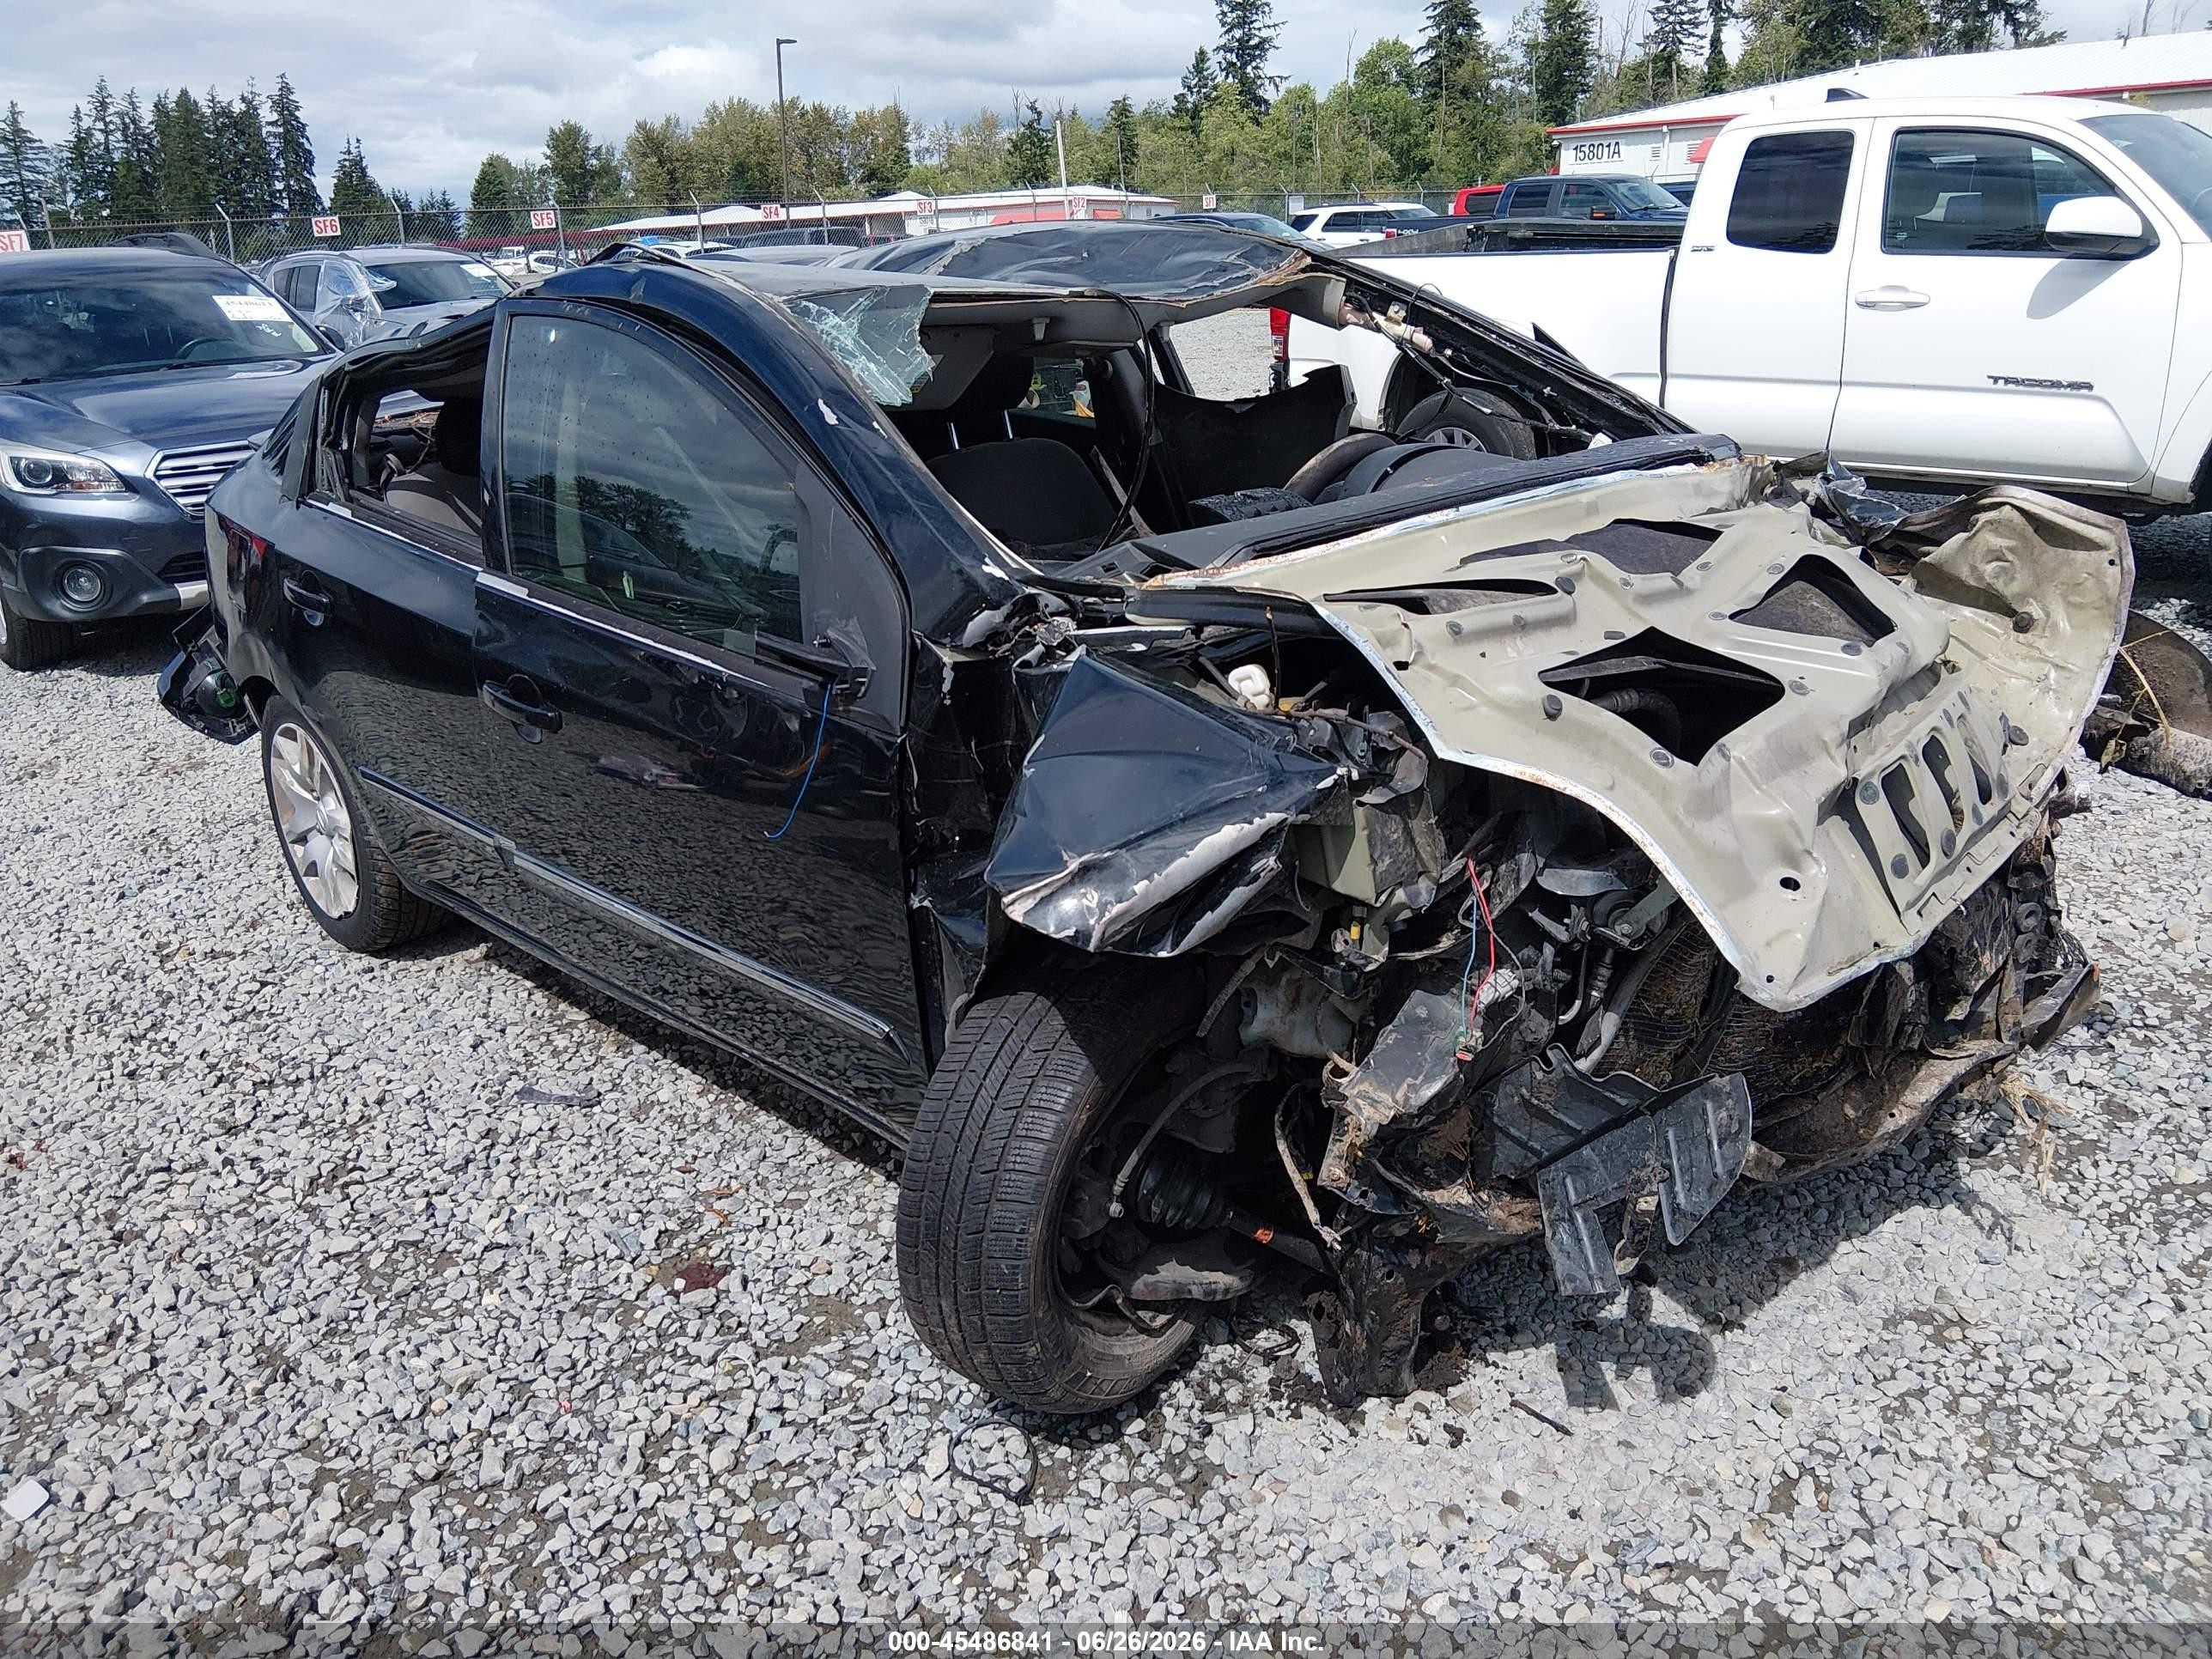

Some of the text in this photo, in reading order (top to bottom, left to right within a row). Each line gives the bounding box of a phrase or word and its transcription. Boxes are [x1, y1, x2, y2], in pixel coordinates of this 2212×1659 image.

[1572, 141, 1621, 161] 15801A
[918, 202, 933, 214] SF3
[1073, 197, 1085, 208] SF2
[532, 212, 554, 227] SF5
[763, 206, 779, 219] SF4
[314, 218, 338, 234] SF6
[1986, 375, 2094, 392] TACOMA
